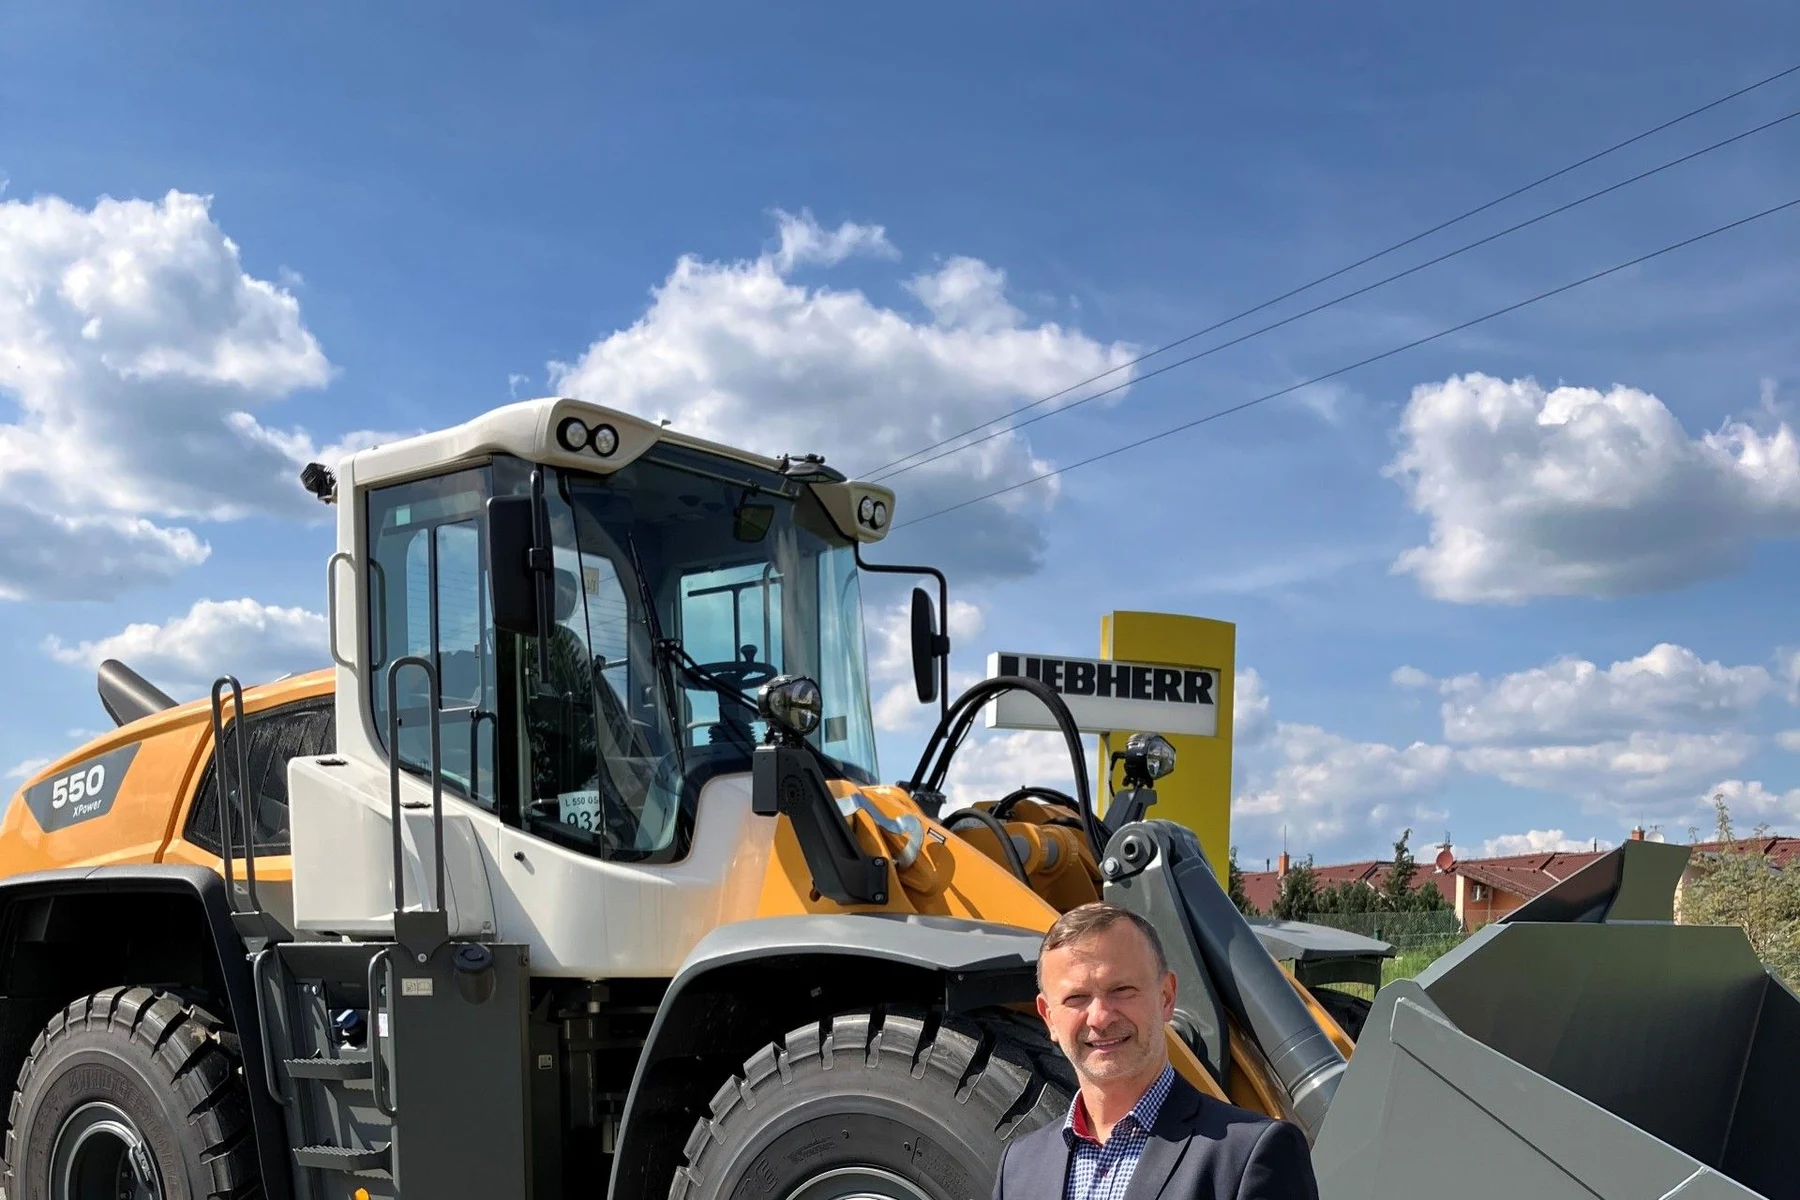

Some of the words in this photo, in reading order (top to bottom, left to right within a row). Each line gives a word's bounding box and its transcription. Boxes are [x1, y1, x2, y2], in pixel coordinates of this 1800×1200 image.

[52, 764, 105, 809] 550
[72, 799, 102, 818] XPower
[572, 797, 586, 806] 550
